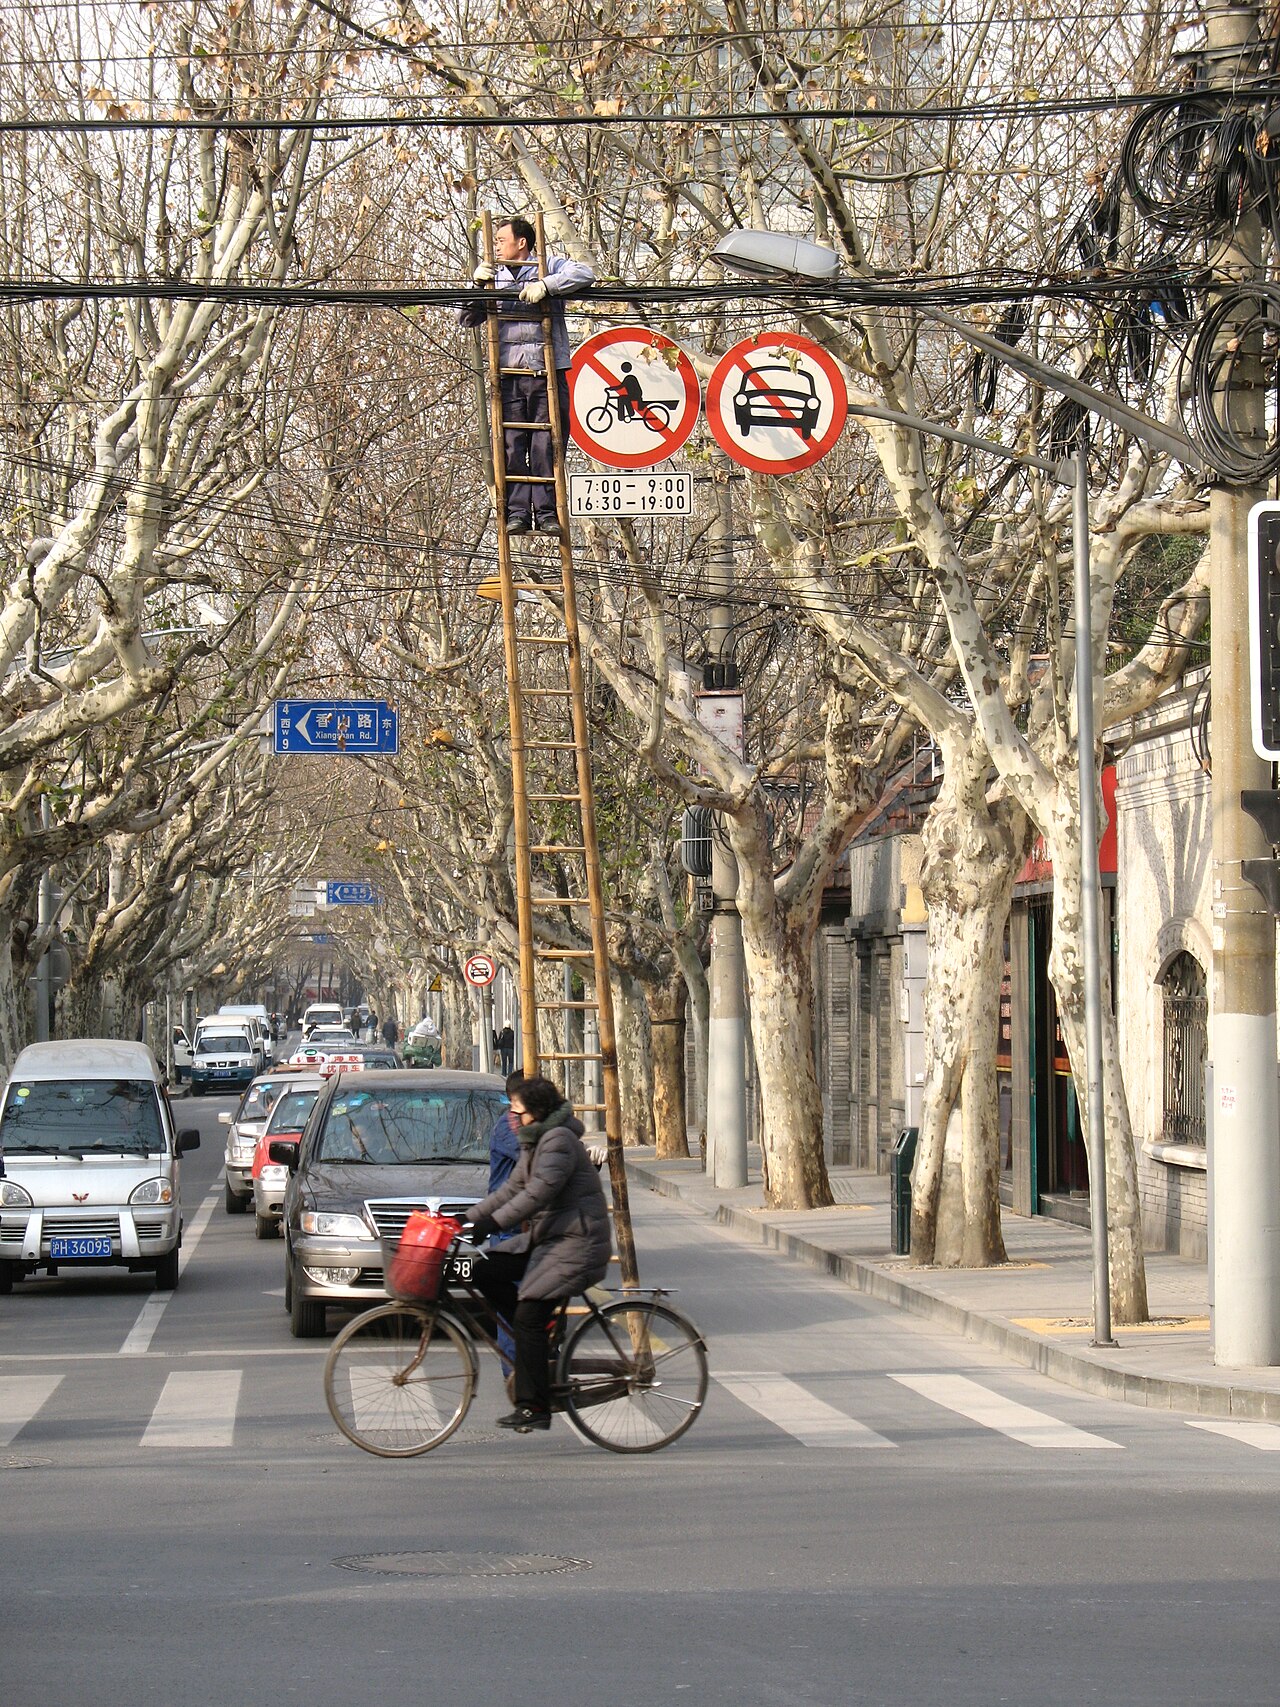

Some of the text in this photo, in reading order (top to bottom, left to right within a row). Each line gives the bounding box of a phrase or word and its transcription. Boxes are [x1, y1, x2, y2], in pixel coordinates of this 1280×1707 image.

[282, 703, 289, 715] 4
[280, 718, 291, 728] 西
[315, 712, 372, 729] 香山路
[381, 718, 392, 729] 东
[359, 731, 372, 739] Rd.
[282, 738, 289, 750] 9
